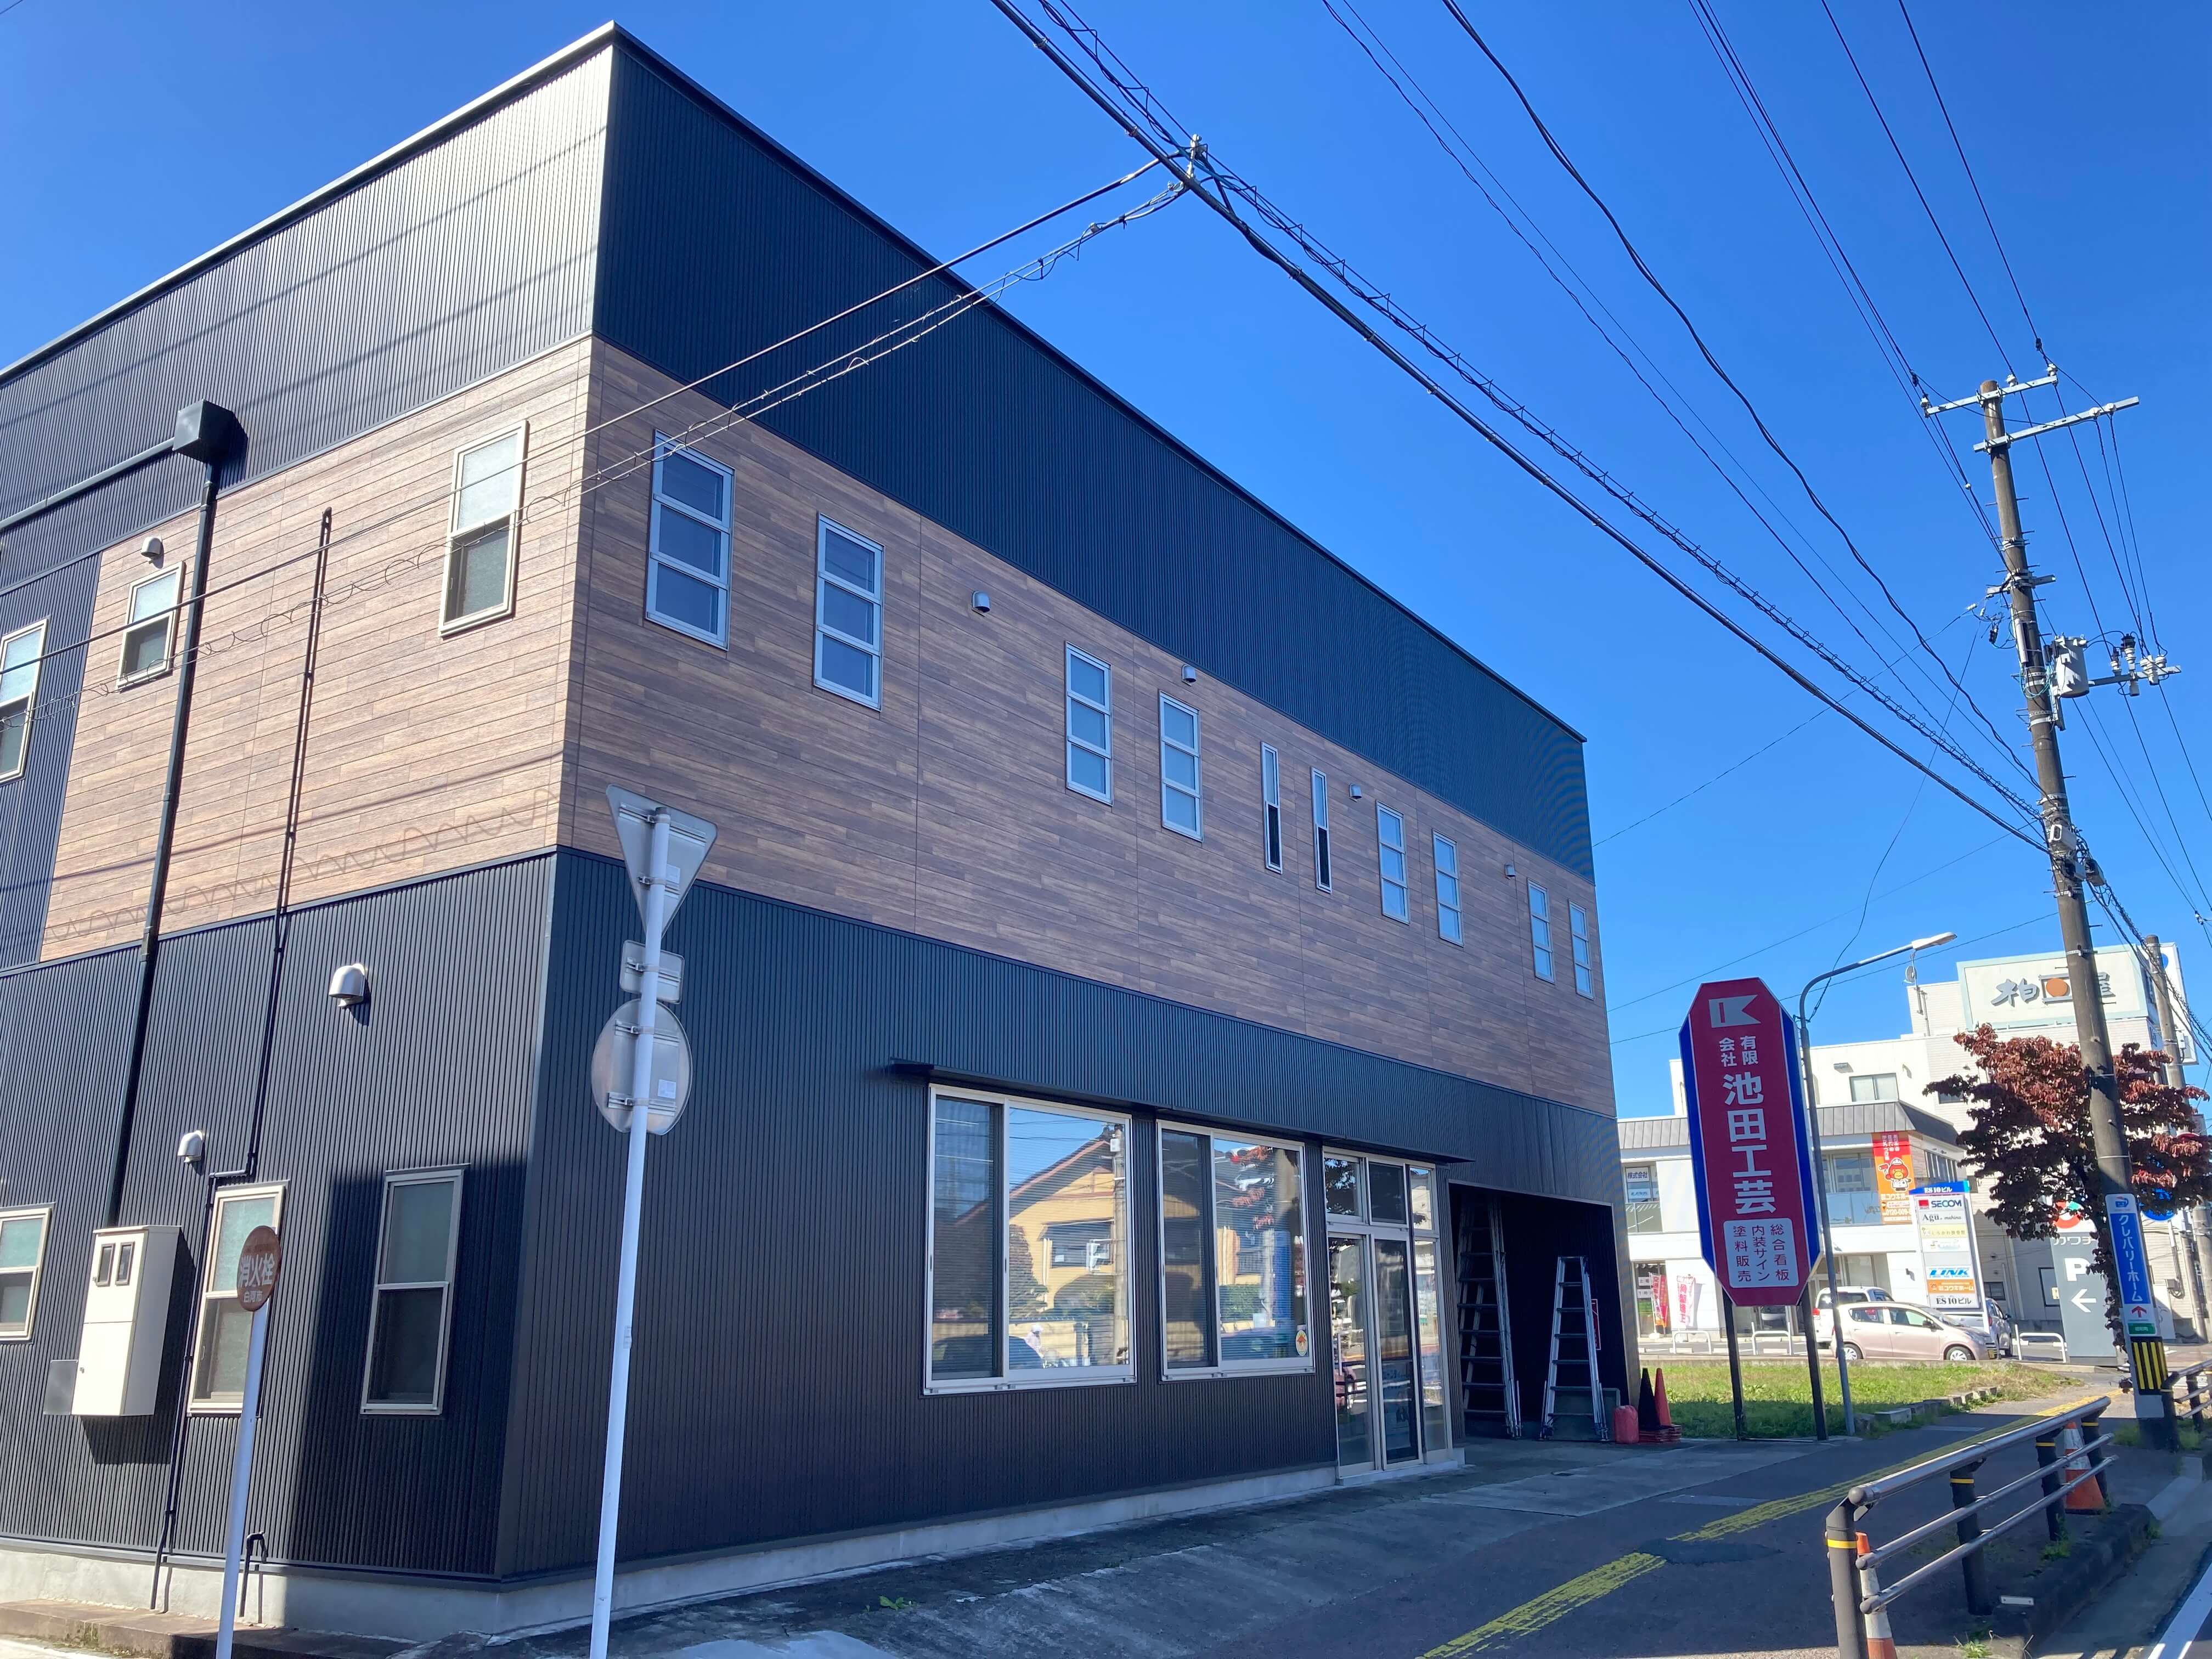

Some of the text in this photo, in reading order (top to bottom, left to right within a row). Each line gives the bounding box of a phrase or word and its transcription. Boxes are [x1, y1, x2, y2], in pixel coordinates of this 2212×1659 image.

[1719, 1037, 1737, 1067] 会社
[1740, 1036, 1758, 1065] 有限
[1722, 1071, 1776, 1214] 池田工芸
[239, 1253, 275, 1287] 消火栓
[1733, 1226, 1751, 1282] 塗料販売
[1752, 1225, 1770, 1281] 内装サイン
[1770, 1224, 1790, 1280] 総合看板
[2064, 1257, 2090, 1282] P
[2119, 1215, 2143, 1301] クレバリーホーム
[243, 1290, 263, 1303] 白河市
